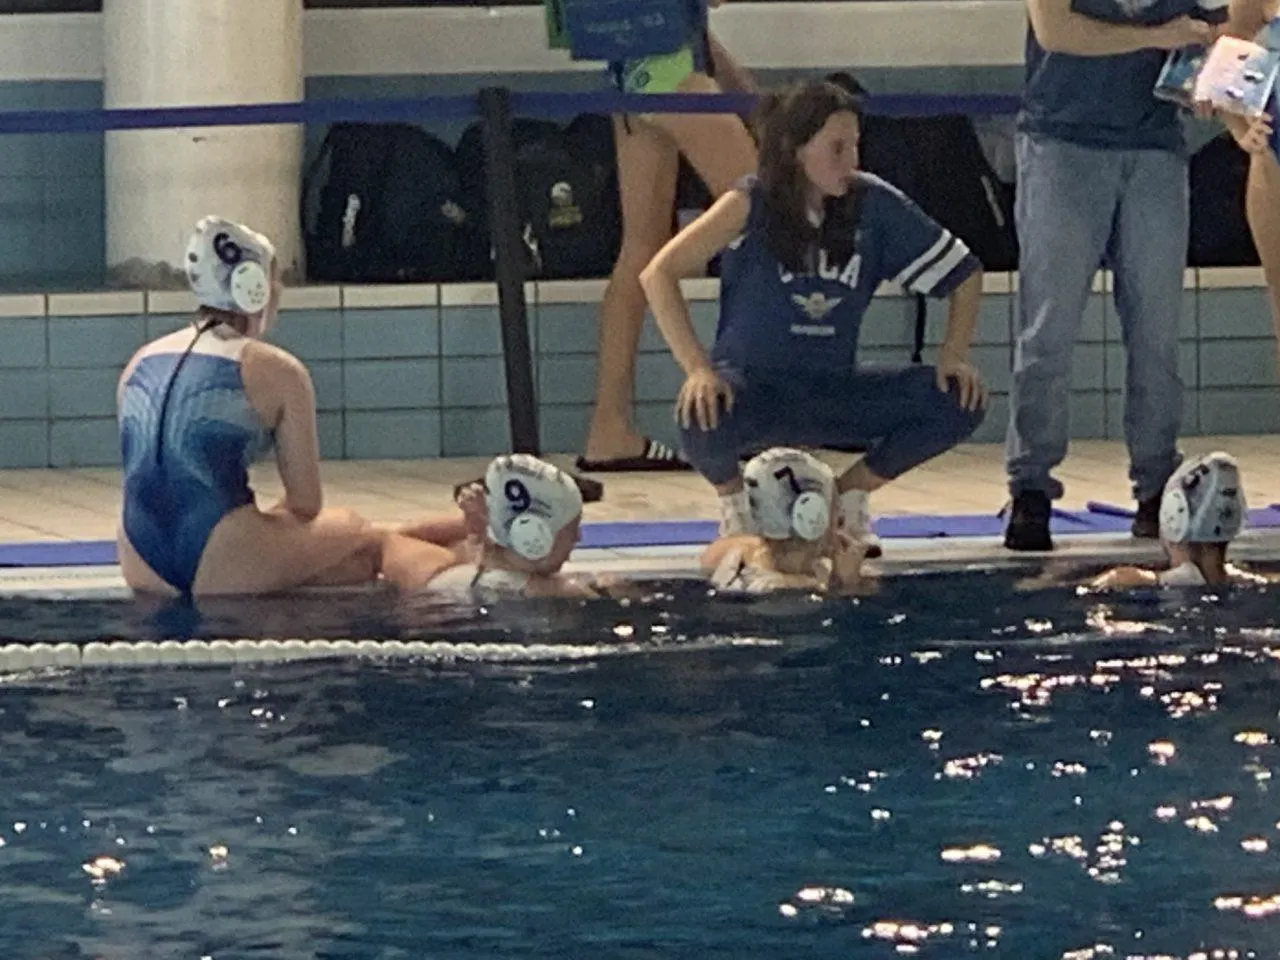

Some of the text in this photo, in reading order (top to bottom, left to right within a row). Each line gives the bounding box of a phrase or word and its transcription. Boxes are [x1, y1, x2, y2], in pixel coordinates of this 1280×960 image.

[212, 231, 243, 266] 6
[504, 477, 532, 514] 9
[773, 464, 802, 494] 7
